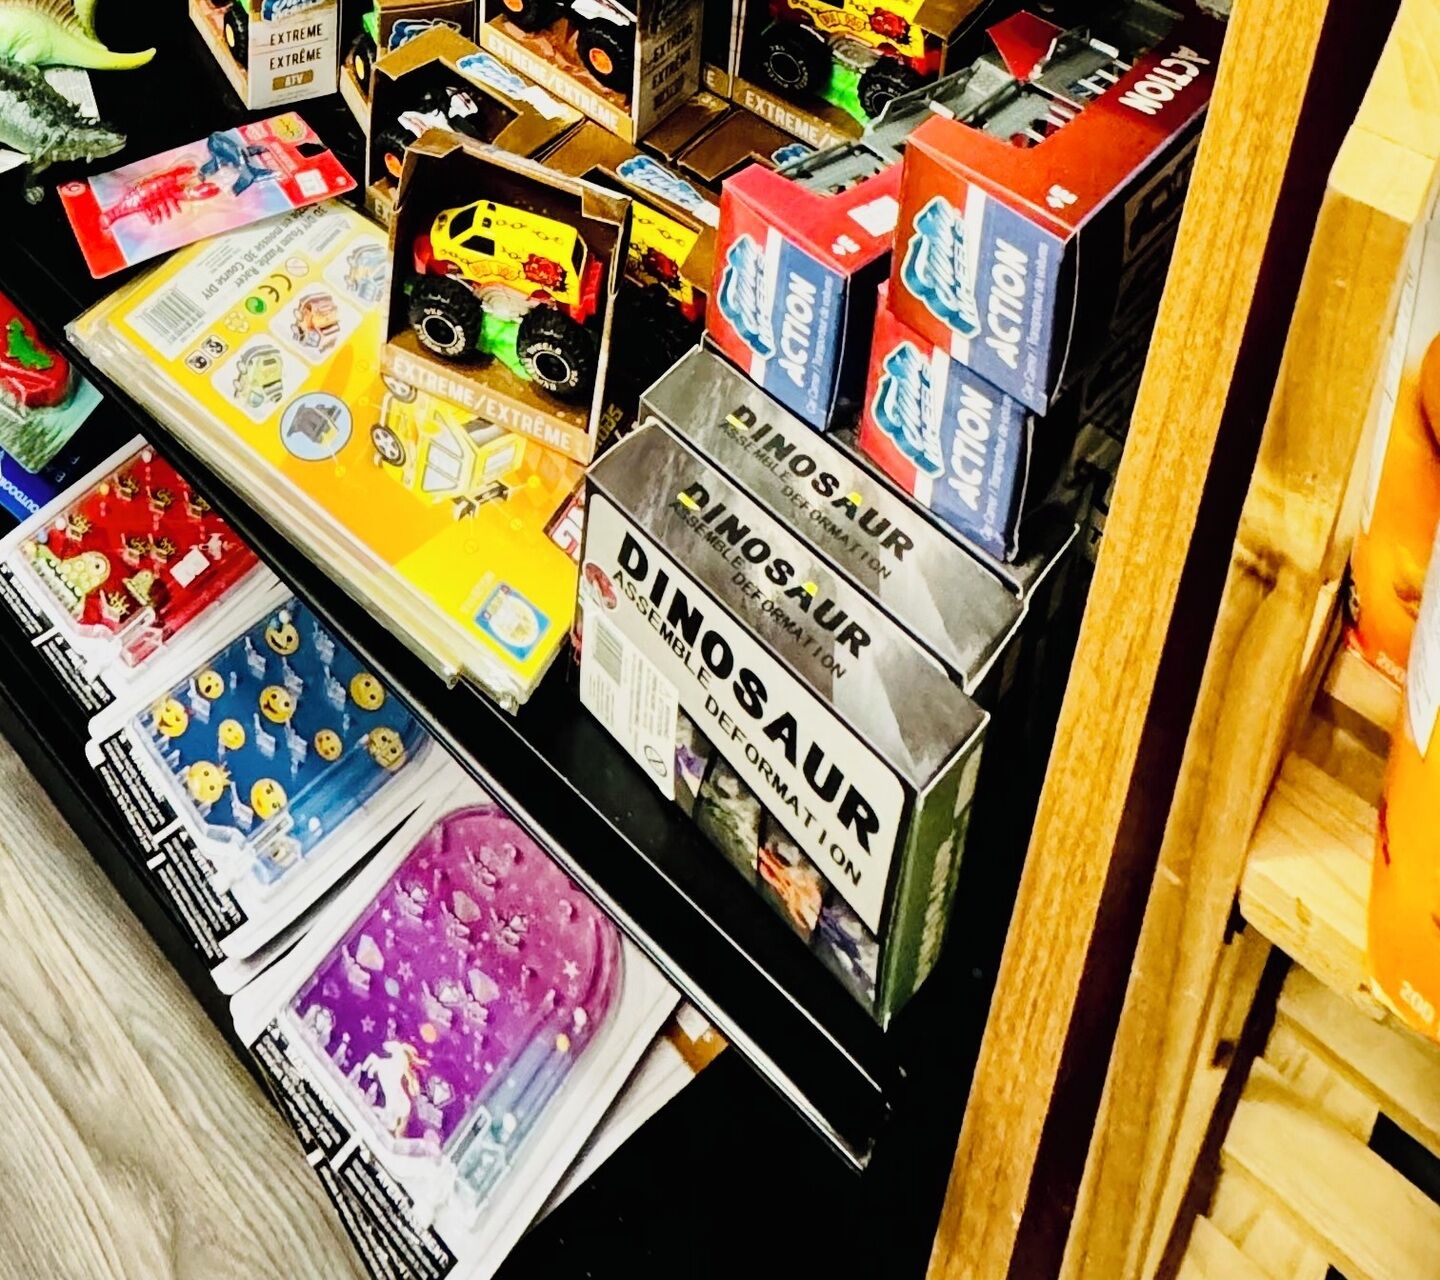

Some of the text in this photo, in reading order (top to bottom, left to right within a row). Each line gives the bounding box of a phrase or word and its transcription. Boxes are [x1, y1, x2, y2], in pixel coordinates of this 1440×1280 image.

[269, 47, 323, 71] EXTRÊME
[270, 23, 323, 47] EXTREME
[283, 73, 305, 87] ATV
[1116, 44, 1212, 116] ACTION
[201, 285, 220, 301] DIY
[216, 262, 246, 288] Course
[233, 266, 260, 289] Racer
[777, 271, 818, 388] ACTION
[985, 238, 1029, 370] ACTION
[718, 421, 892, 581] ASSEMBLE DEFORMATION
[725, 403, 915, 563] DINOSAUR
[947, 383, 995, 513] ACTION
[668, 501, 848, 680] ASSEMBLE DEFORMATION
[677, 481, 872, 660] DINOSAUR
[612, 569, 710, 691] ASSEMBLE
[704, 692, 862, 889] DEFORMATION
[617, 529, 881, 857] DINOSAUR
